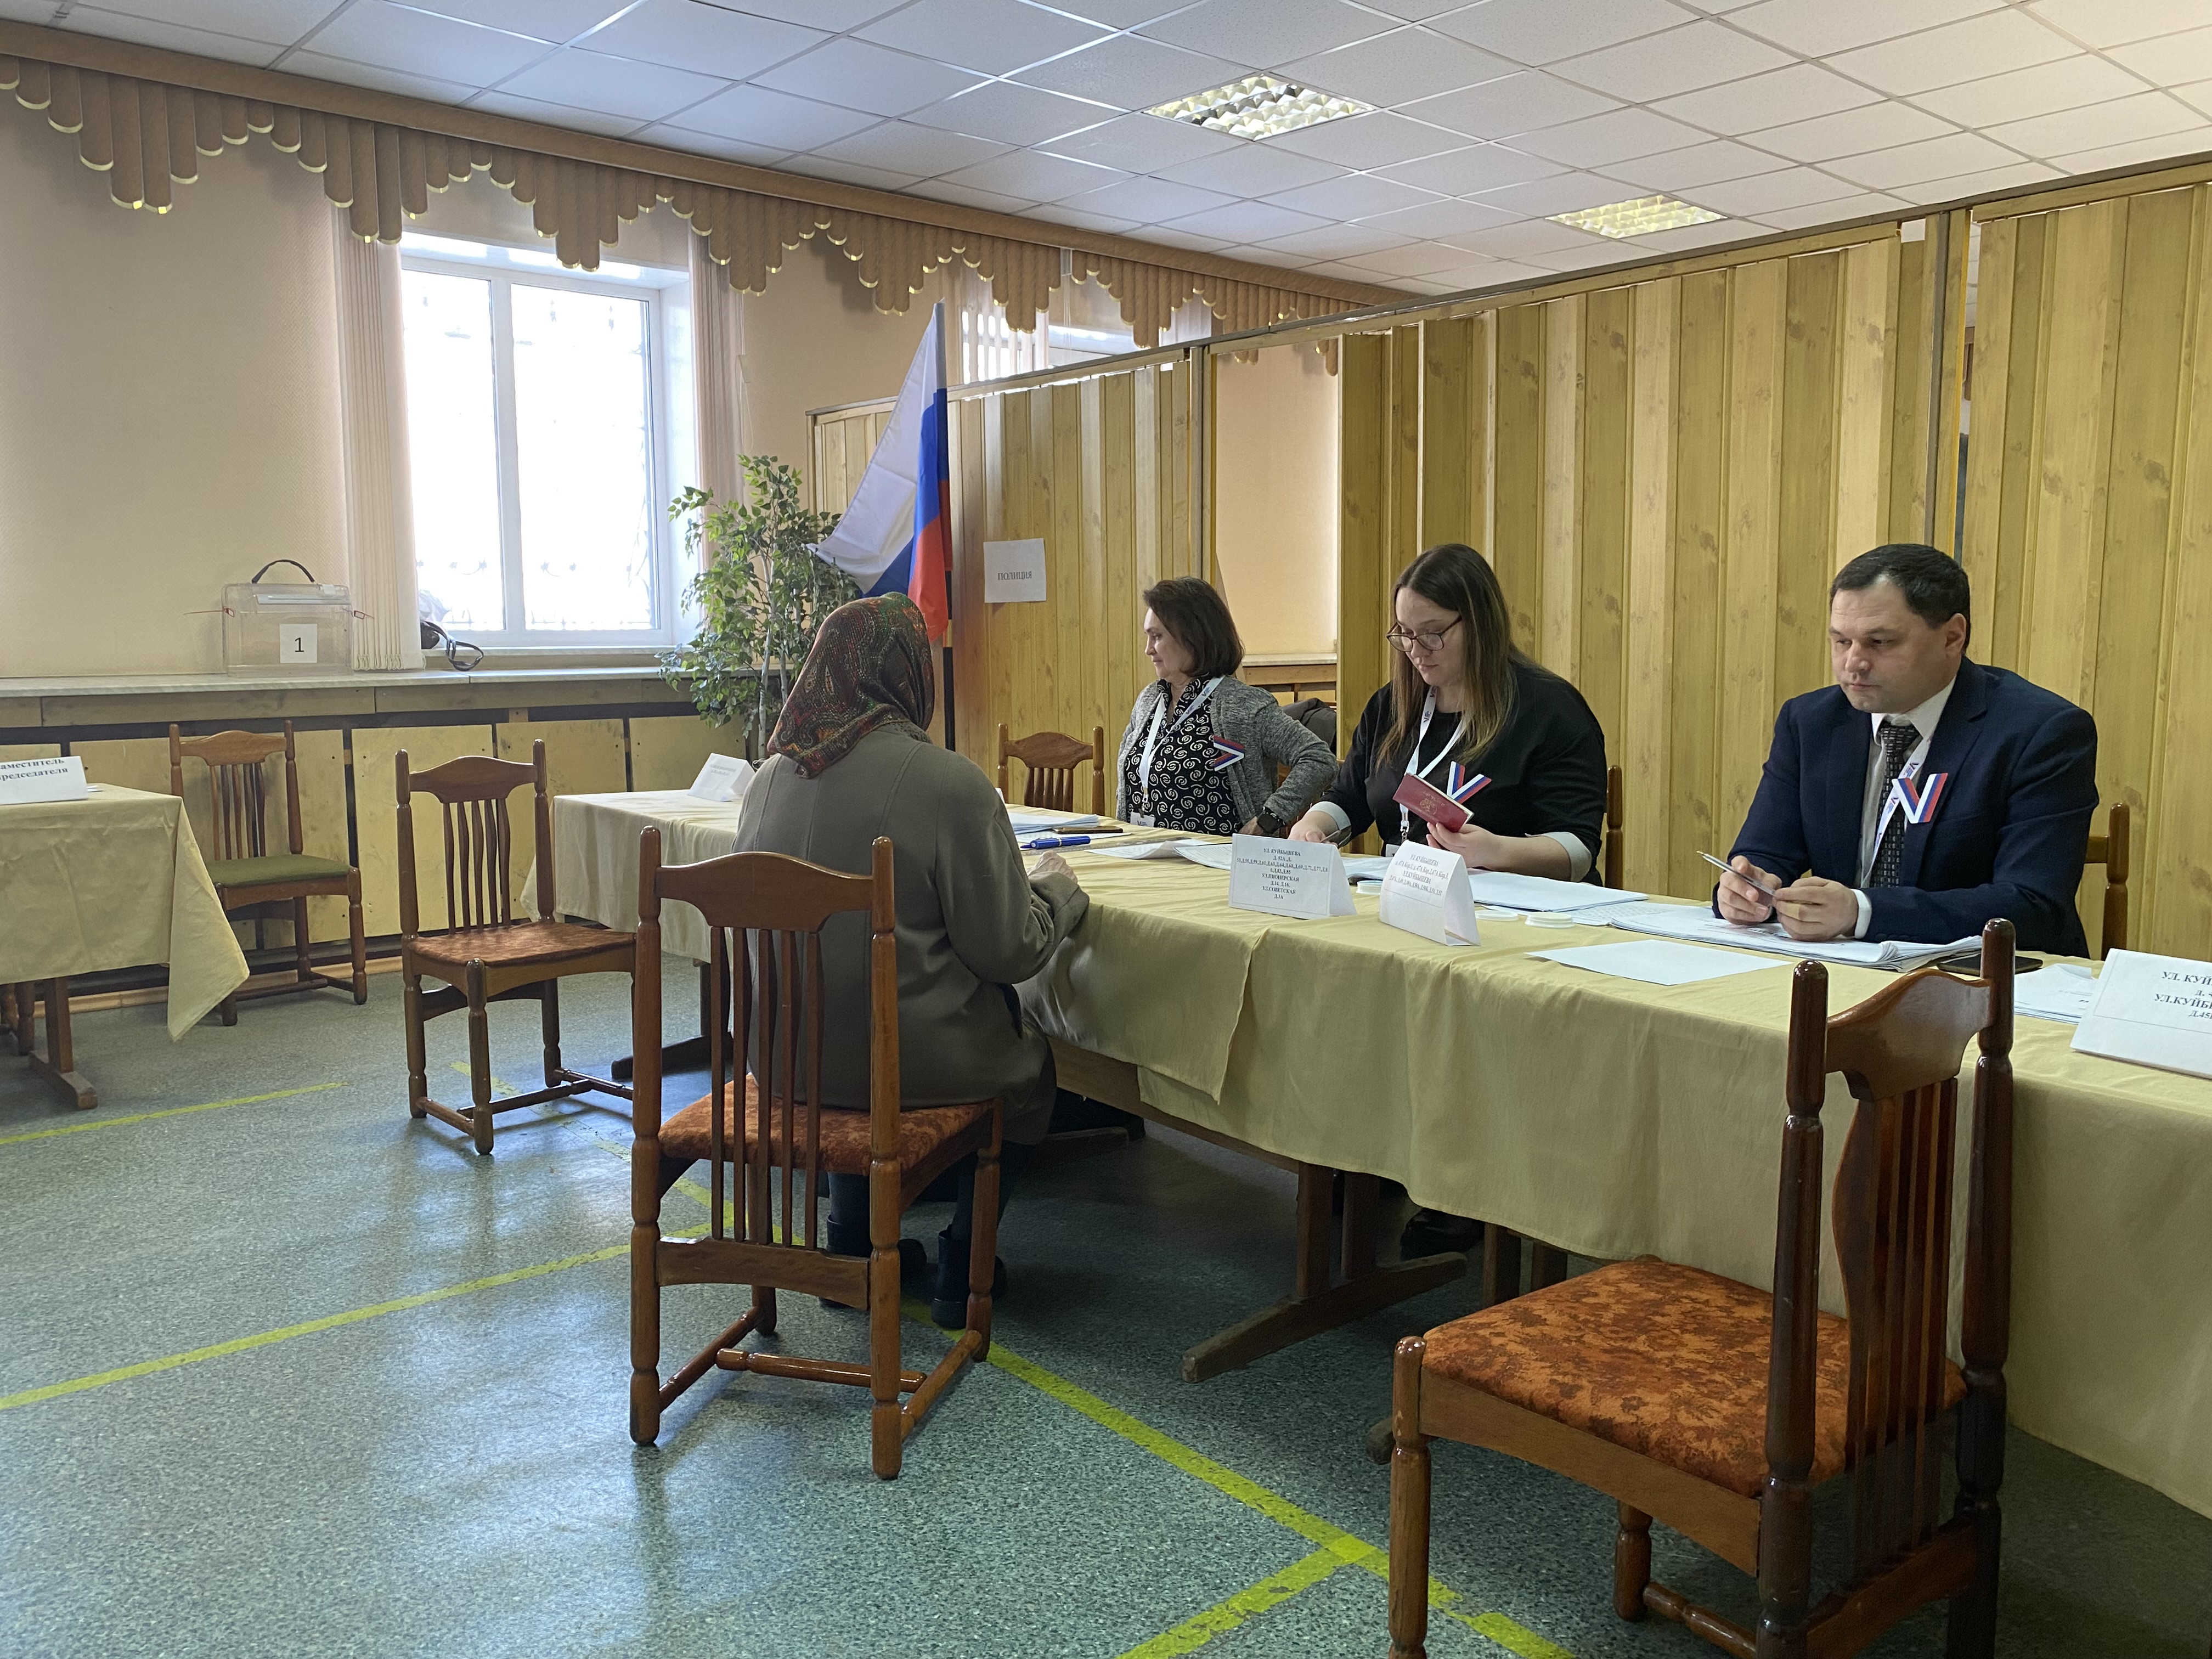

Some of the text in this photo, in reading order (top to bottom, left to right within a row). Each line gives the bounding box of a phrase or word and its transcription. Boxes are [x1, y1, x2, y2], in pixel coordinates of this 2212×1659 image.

[997, 571, 1032, 580] ПОЛИЦИЯ
[295, 637, 304, 647] 1
[0, 758, 65, 769] аместитель
[2162, 971, 2212, 986] УЛ. КУЙ
